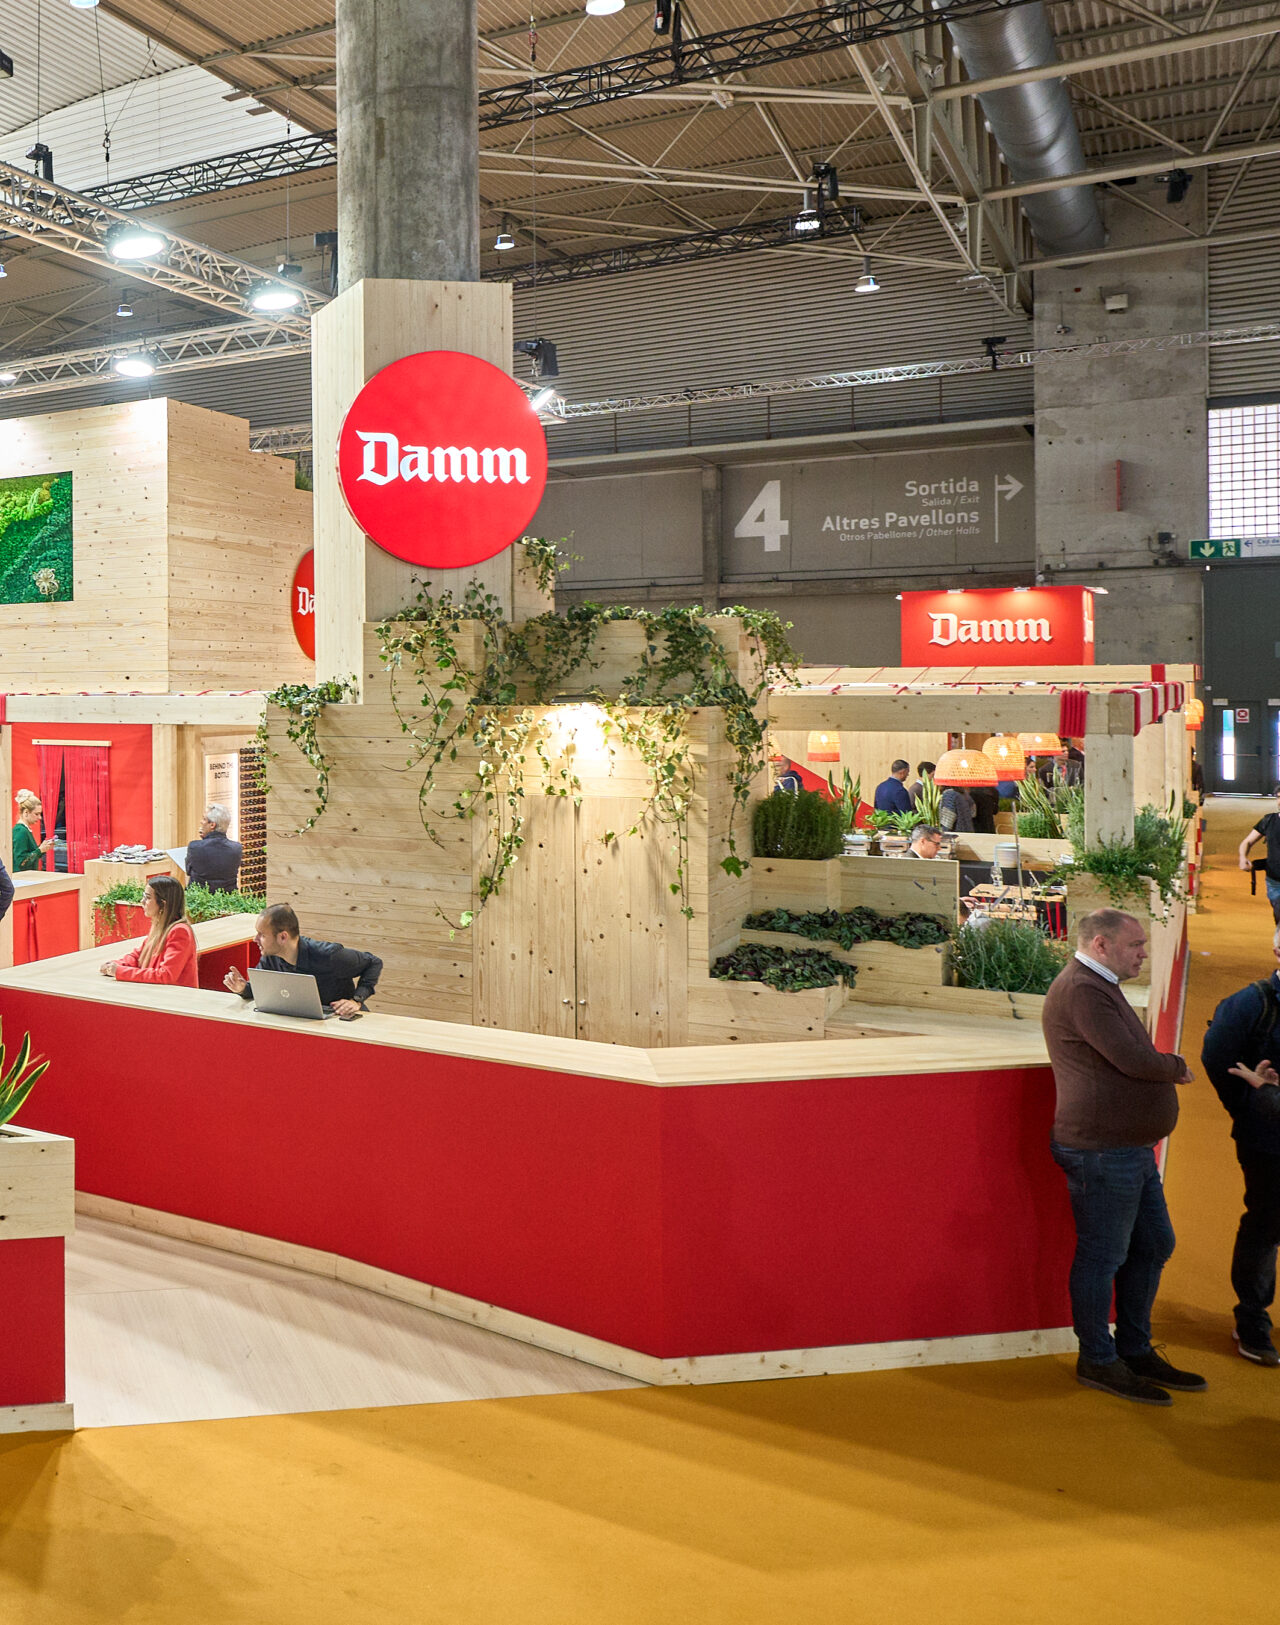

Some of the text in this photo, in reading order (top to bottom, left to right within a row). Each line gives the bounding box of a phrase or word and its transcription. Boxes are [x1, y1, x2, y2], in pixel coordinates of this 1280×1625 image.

[355, 430, 531, 486] Damm
[905, 477, 979, 497] Sortida
[921, 497, 952, 508] Salida
[959, 495, 981, 506] Exit
[734, 480, 789, 552] 4
[821, 508, 979, 532] Altres Pavellons
[839, 531, 866, 542] Otros
[867, 529, 917, 541] Pabellones
[925, 526, 953, 538] Other
[955, 525, 980, 536] Halls
[927, 611, 1054, 646] Damm
